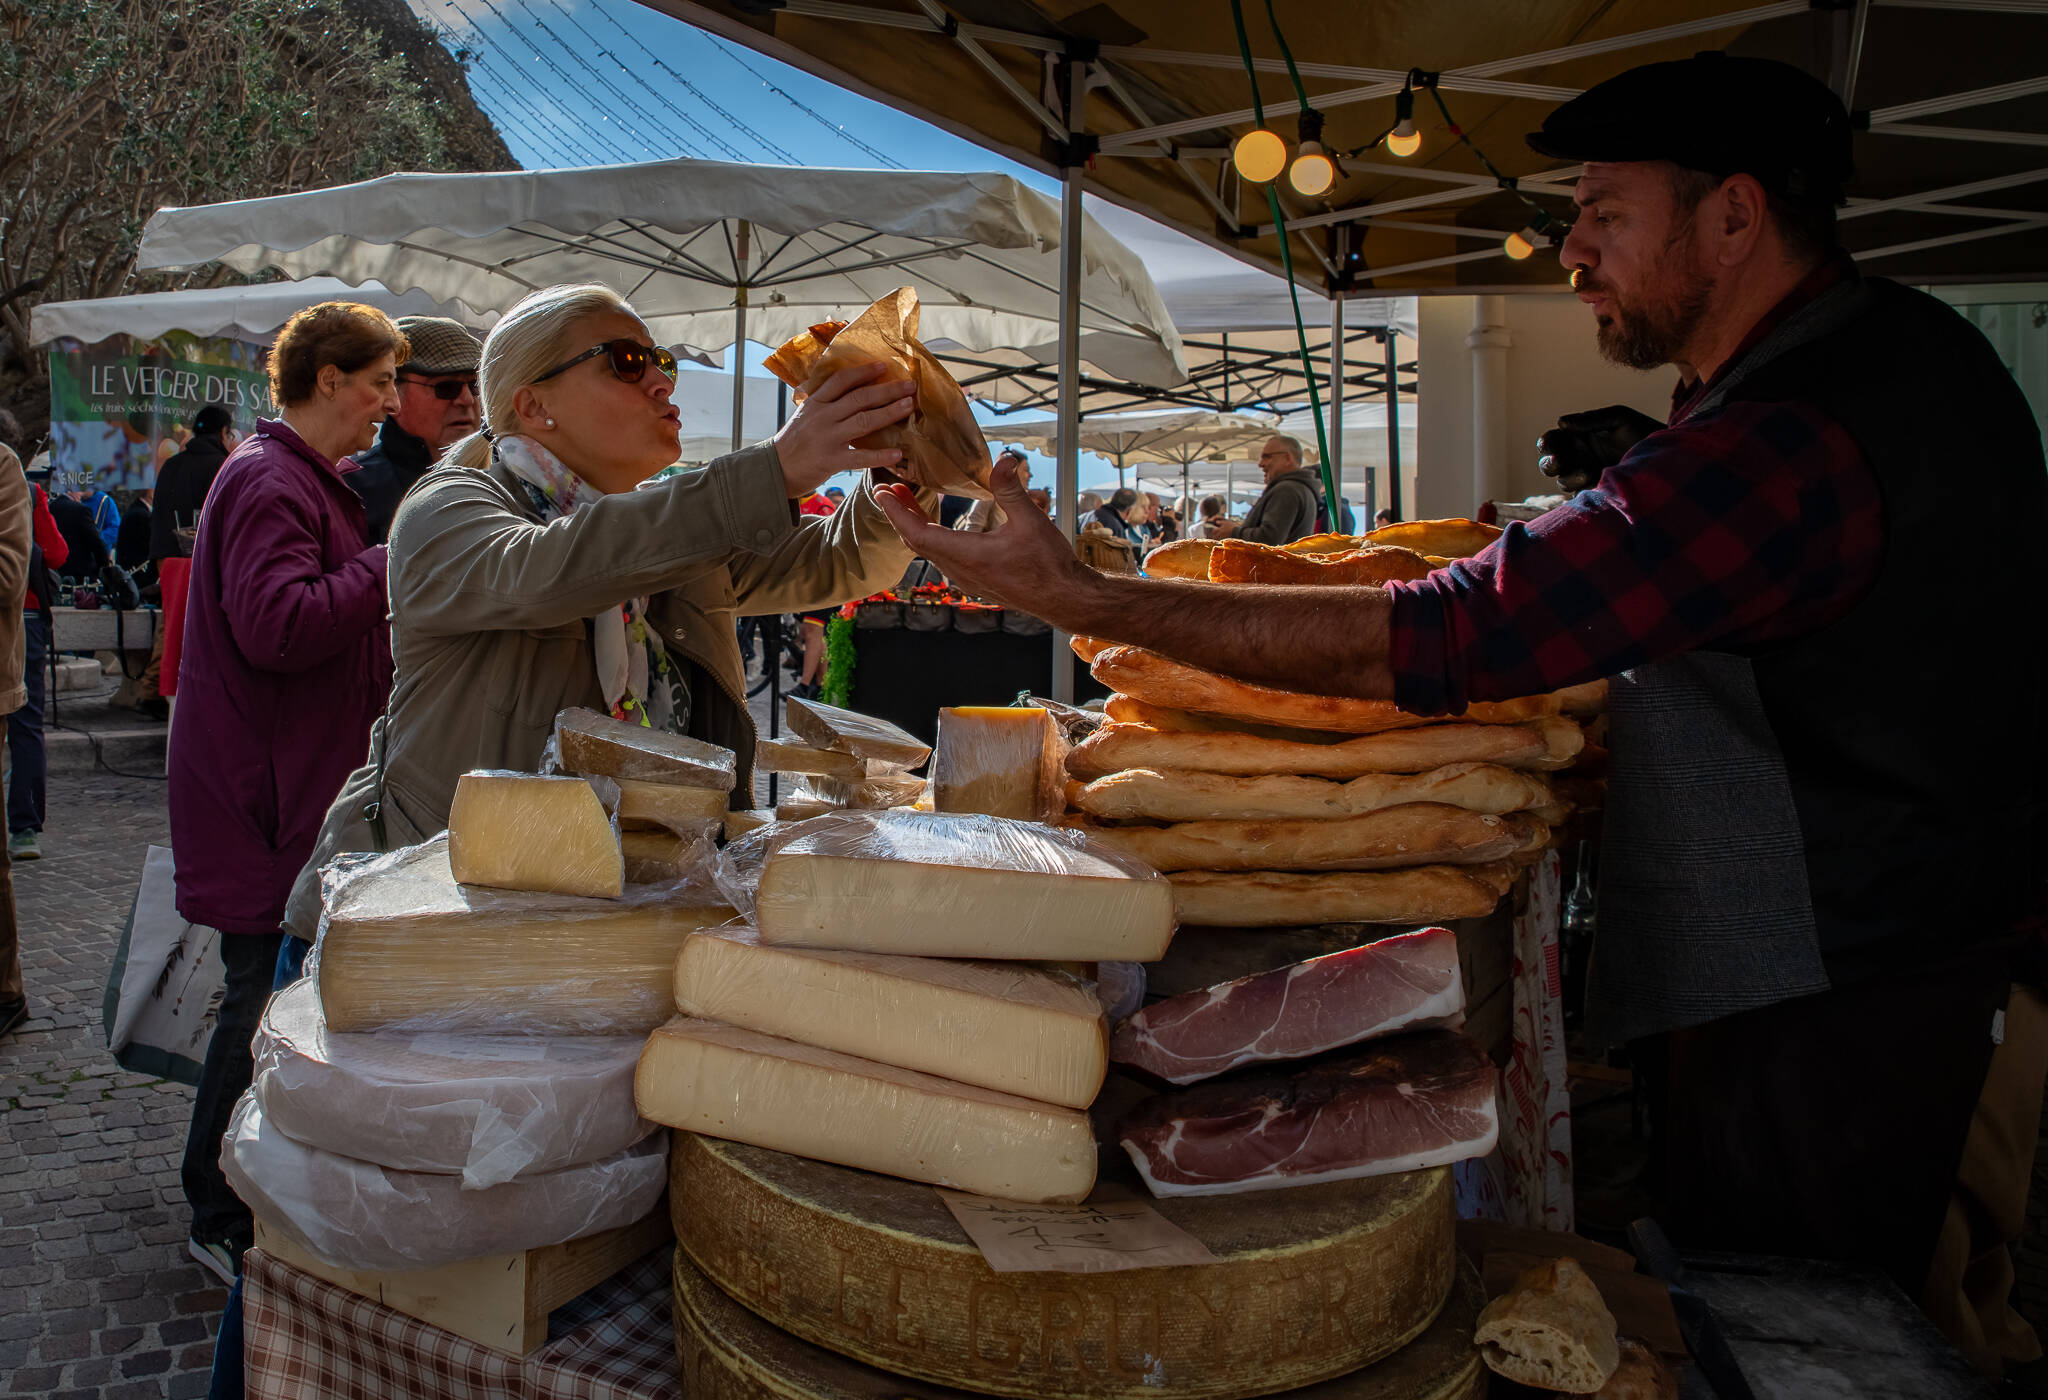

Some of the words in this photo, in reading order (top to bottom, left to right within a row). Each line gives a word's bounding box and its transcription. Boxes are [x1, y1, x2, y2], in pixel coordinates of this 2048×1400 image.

[91, 364, 116, 396] LE
[204, 375, 245, 407] DES
[248, 383, 277, 414] SA
